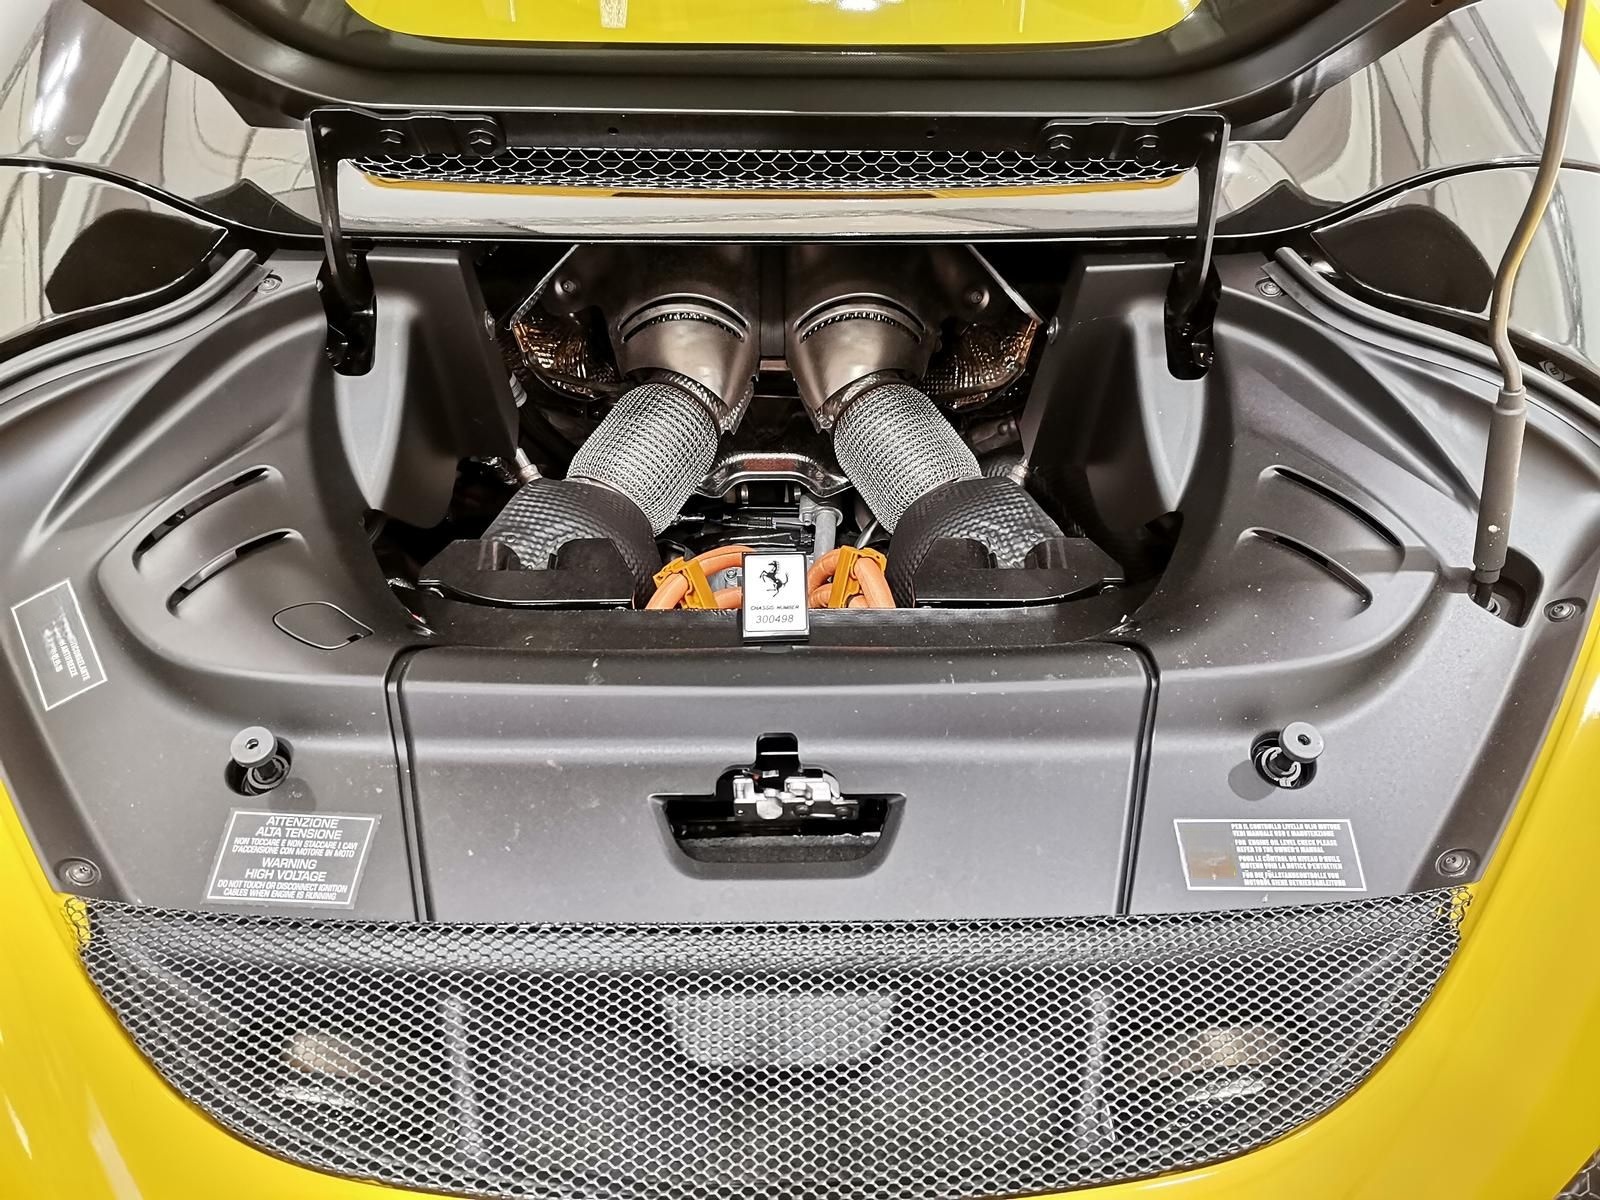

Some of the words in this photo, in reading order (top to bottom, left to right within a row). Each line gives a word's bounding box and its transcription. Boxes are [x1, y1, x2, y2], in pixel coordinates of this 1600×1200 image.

[756, 614, 794, 624] 300498
[266, 816, 340, 828] ATTENZIONE
[255, 826, 282, 838] ALTA
[285, 828, 344, 840] TENSIONE
[234, 837, 250, 845] NON
[251, 838, 280, 846] TOCCARE
[287, 839, 303, 848] NON
[304, 840, 337, 849] STACCARE
[342, 842, 358, 850] CAVI
[232, 845, 280, 854] D'ACCENSIONE
[295, 848, 325, 856] MOTORE
[334, 849, 355, 858] MOTO
[262, 857, 318, 870] WARNING
[245, 868, 274, 880] HIGH
[277, 870, 327, 882] VOLTAGE
[217, 880, 228, 888] DO
[228, 880, 244, 888] NOT
[244, 880, 265, 889] TOUCH
[266, 881, 276, 890] OR
[276, 882, 318, 892] DISCONNECT
[318, 883, 348, 893] IGNITION
[223, 888, 249, 896] CABLES
[249, 889, 271, 898] WHEN
[270, 890, 296, 899] ENGINE
[296, 891, 305, 899] IS
[304, 892, 337, 900] RUNNING
